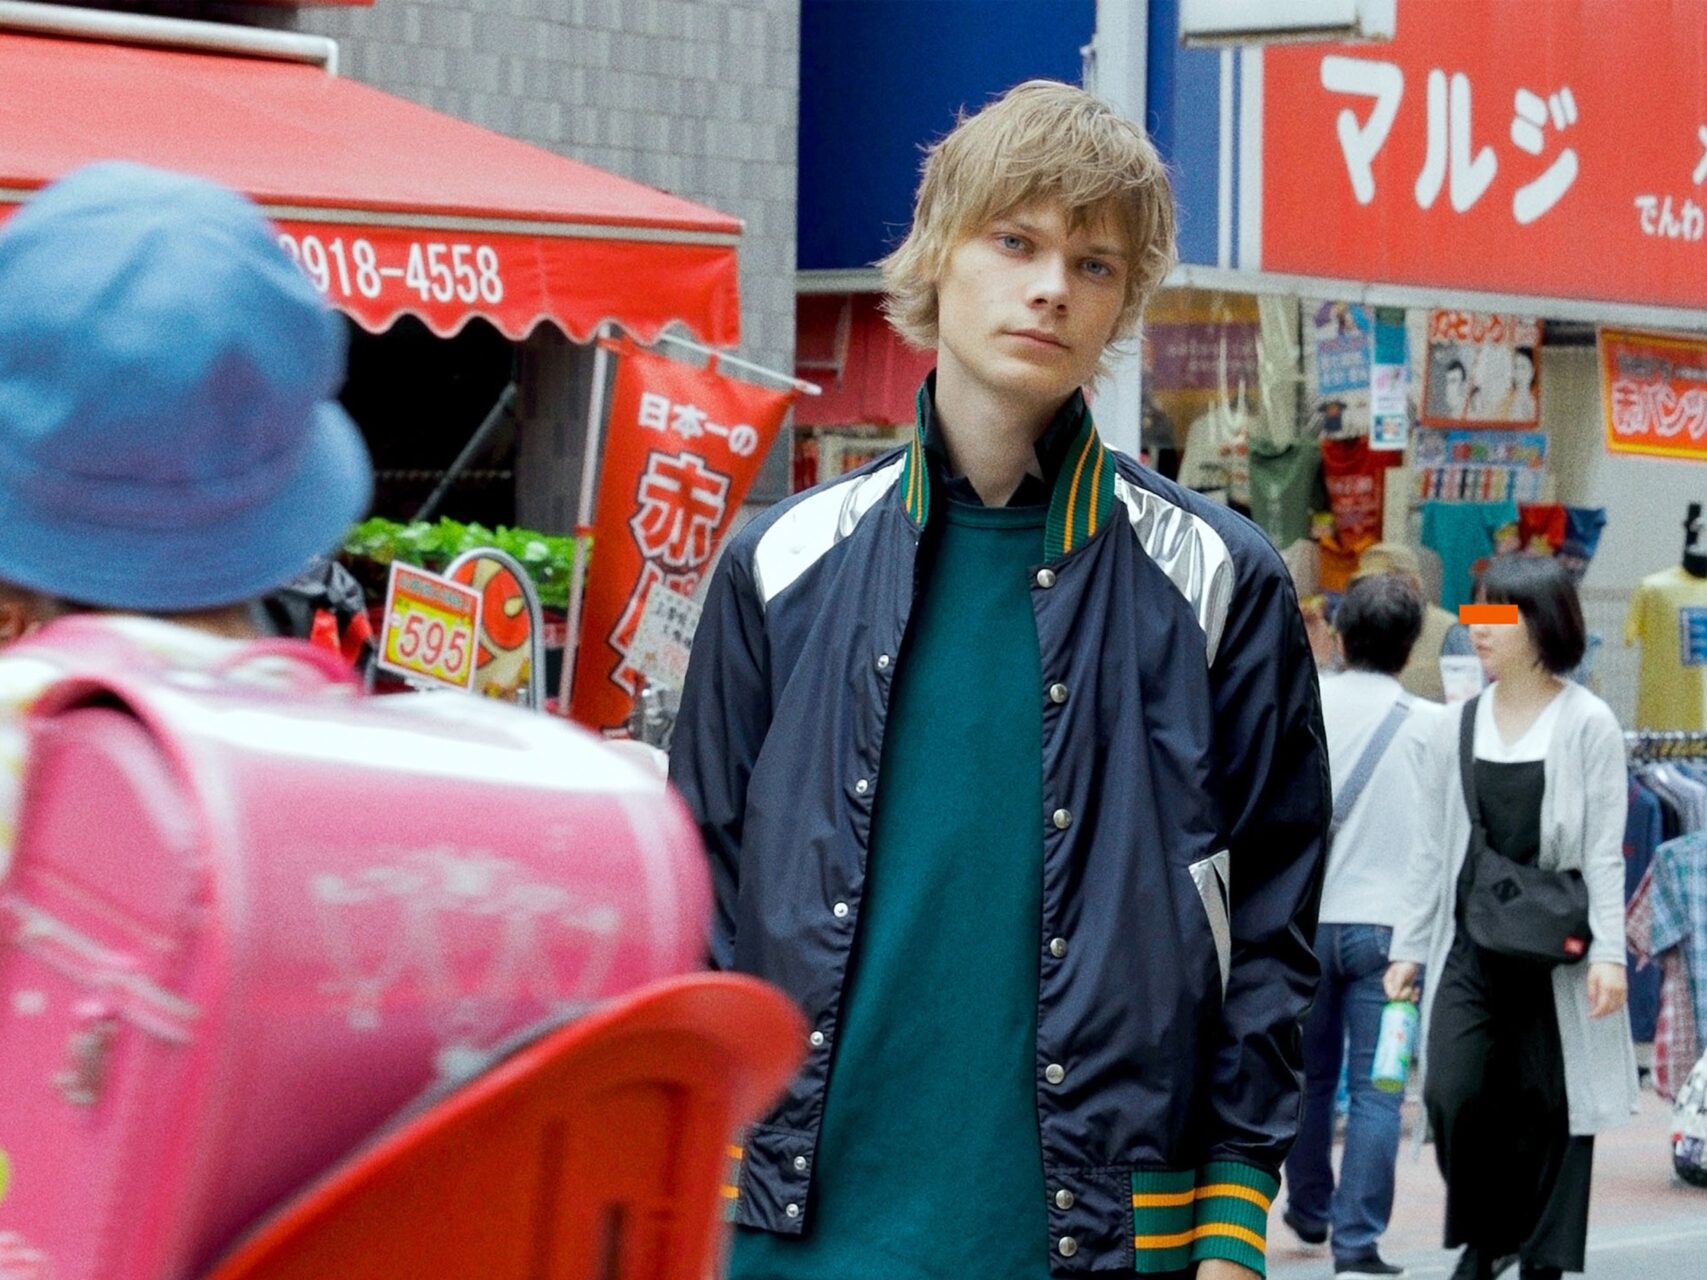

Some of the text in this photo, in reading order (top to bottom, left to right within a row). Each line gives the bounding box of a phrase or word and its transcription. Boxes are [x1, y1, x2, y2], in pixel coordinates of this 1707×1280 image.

[1320, 54, 1579, 226] マルジ
[1634, 194, 1705, 241] でんわ
[277, 233, 503, 304] 918-4558
[638, 391, 759, 457] 日本一の
[398, 612, 468, 675] 595
